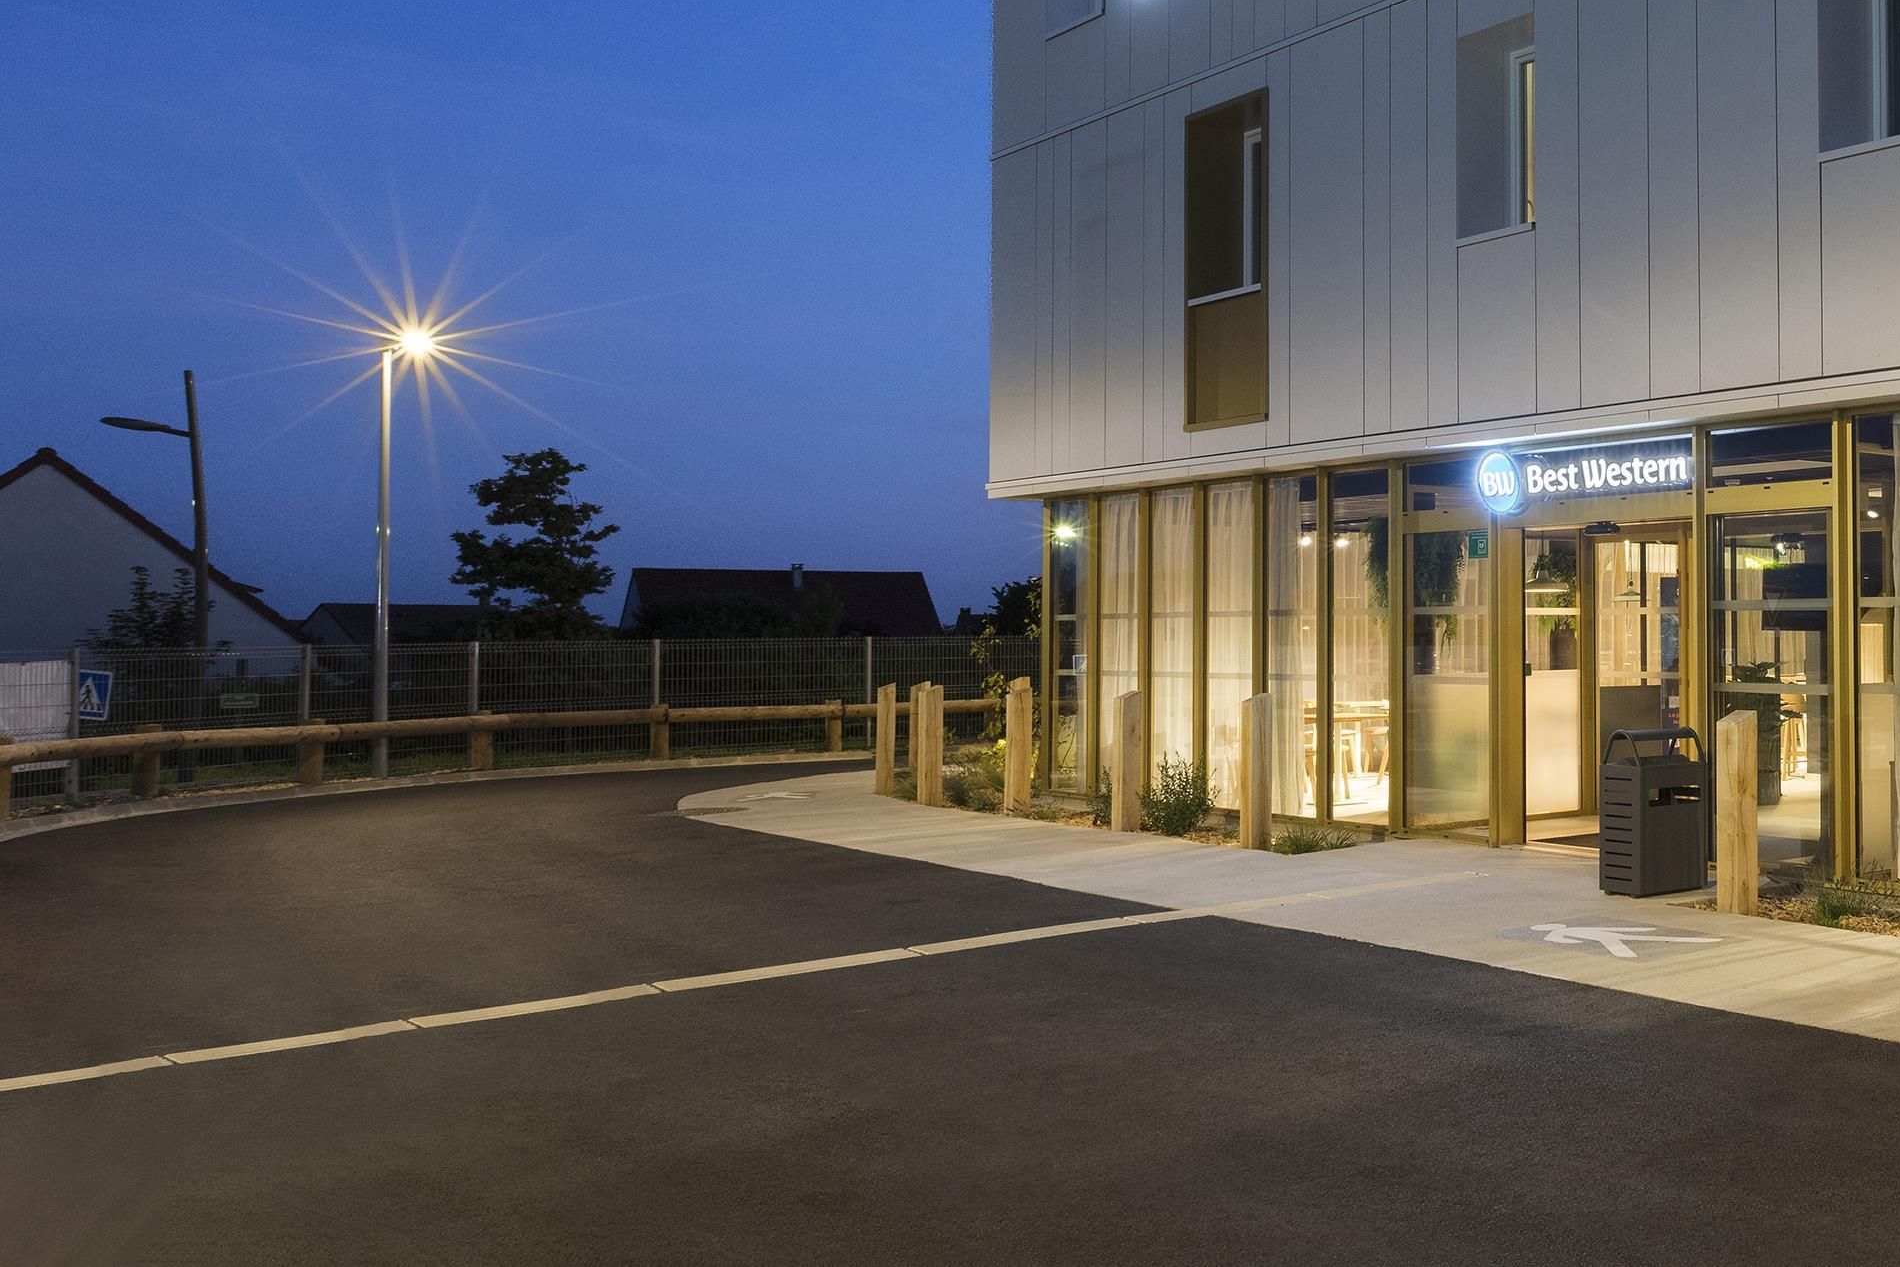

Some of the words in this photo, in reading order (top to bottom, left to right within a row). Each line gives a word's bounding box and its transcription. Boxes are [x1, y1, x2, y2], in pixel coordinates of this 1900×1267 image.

[1483, 470, 1516, 496] BW
[1526, 464, 1579, 494] Best
[1581, 457, 1688, 489] Western
